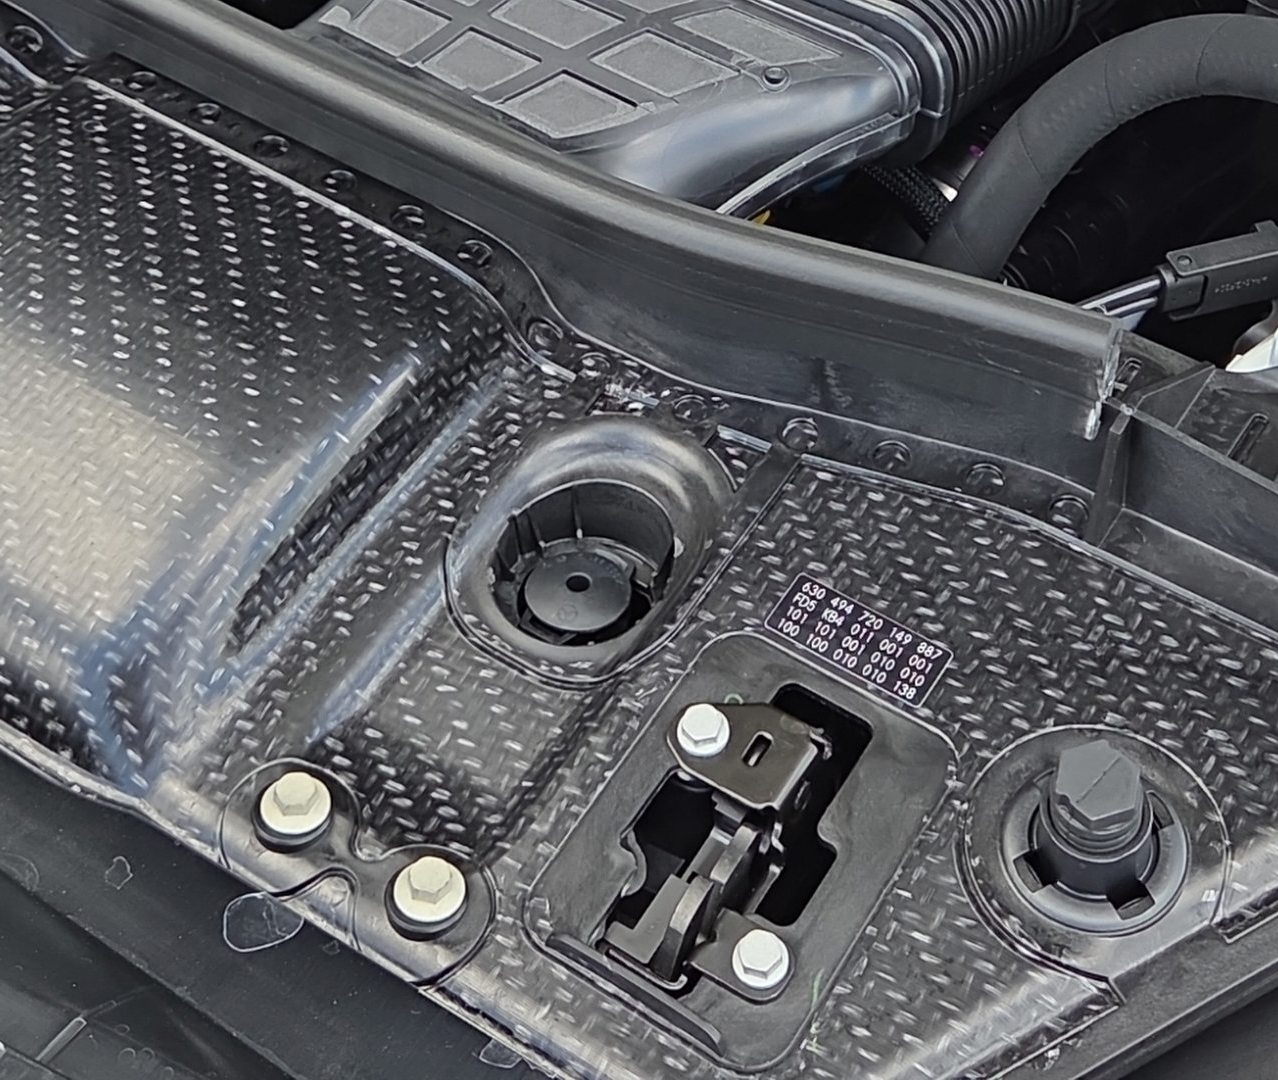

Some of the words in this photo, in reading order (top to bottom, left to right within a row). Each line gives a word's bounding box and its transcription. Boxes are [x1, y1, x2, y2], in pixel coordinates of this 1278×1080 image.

[778, 618, 800, 637] 100
[805, 634, 828, 652] 100
[833, 649, 857, 669] 010
[863, 665, 887, 684] 010
[893, 681, 917, 700] 138
[786, 606, 808, 624] 101
[814, 622, 836, 640] 101
[841, 636, 866, 655] 001
[870, 652, 896, 671] 010
[900, 668, 925, 686] 010
[792, 594, 817, 611] FD5
[821, 609, 844, 626] KB4
[850, 624, 875, 643] 011
[879, 639, 903, 658] 001
[908, 654, 933, 673] 001
[802, 581, 826, 600] 630
[830, 597, 855, 614] 494
[859, 612, 883, 630] 720
[889, 627, 913, 645] 149
[916, 642, 942, 659] 887
